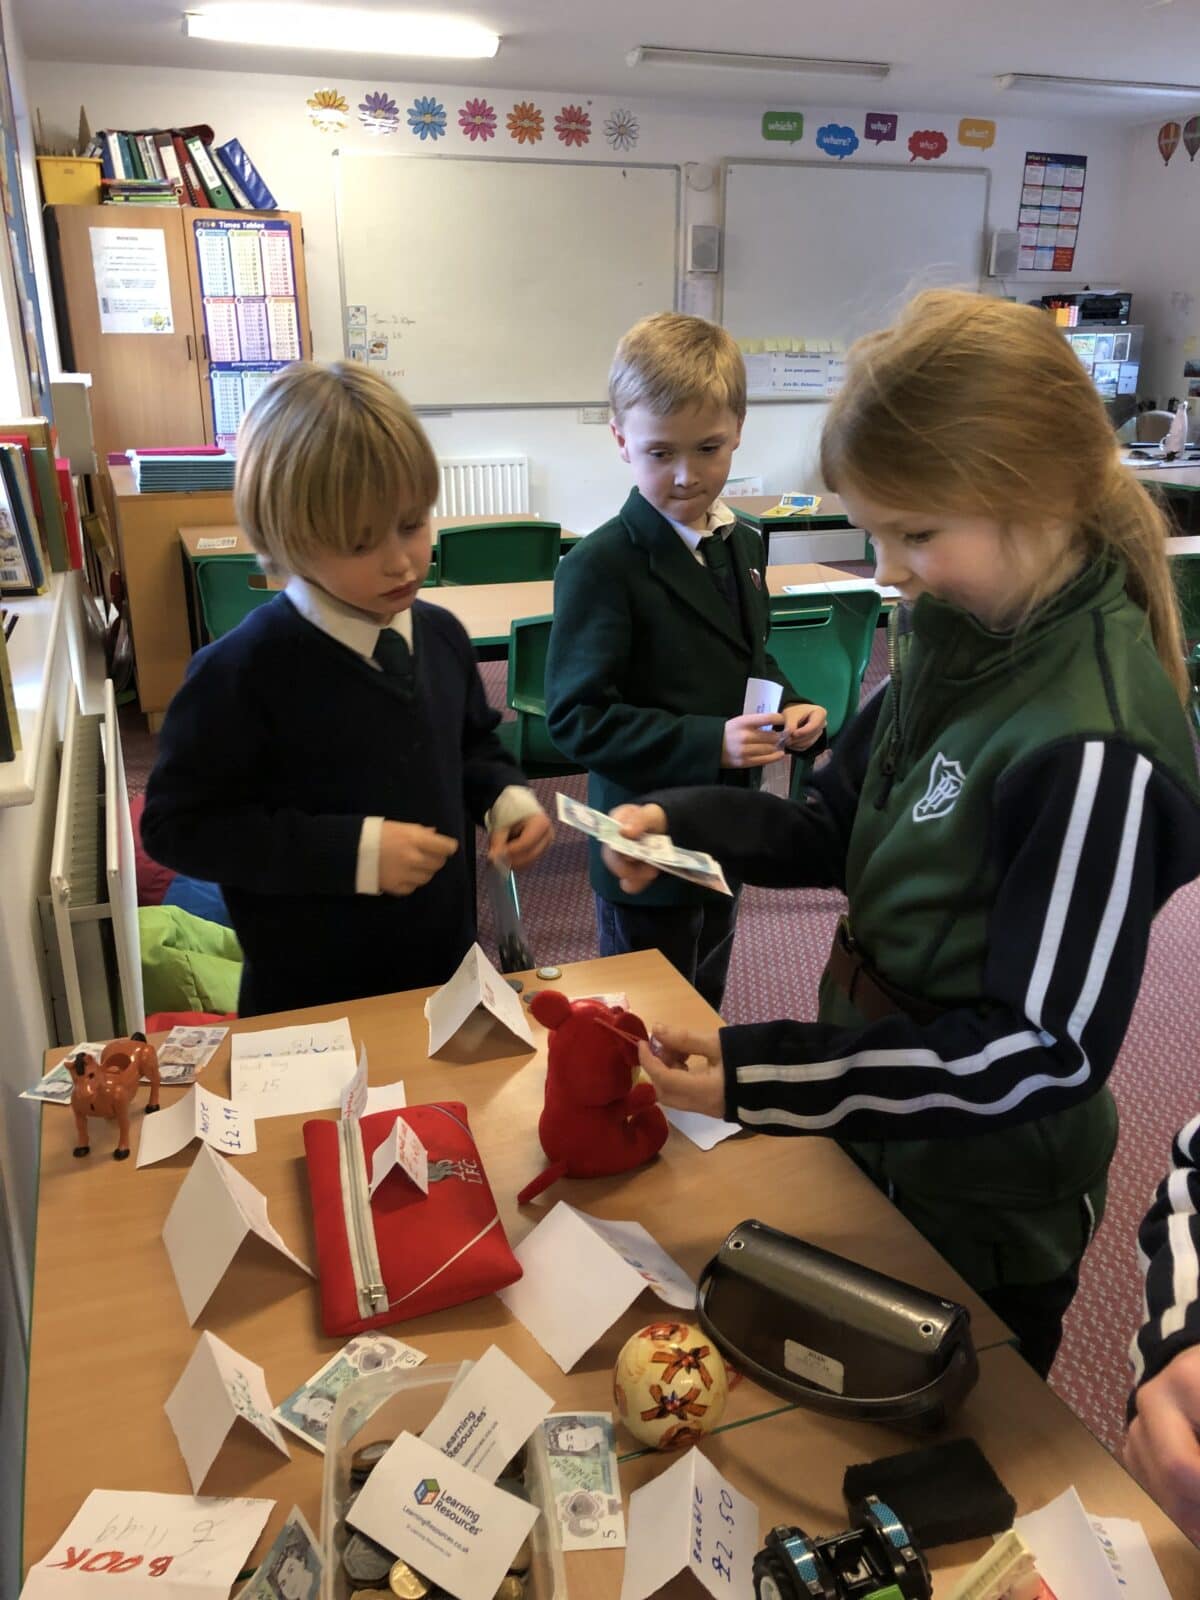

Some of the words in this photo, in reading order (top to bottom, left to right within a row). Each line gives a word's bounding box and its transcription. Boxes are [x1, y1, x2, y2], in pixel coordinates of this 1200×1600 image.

[767, 120, 798, 132] which?
[870, 121, 892, 133] why?
[822, 135, 852, 147] where?
[919, 140, 938, 150] who?
[219, 221, 241, 229] Times
[242, 221, 265, 229] Tables
[463, 1159, 483, 1185] LFC
[440, 1410, 477, 1455] Learning
[433, 1499, 481, 1536] Resources
[440, 1489, 481, 1524] Learning
[711, 1488, 736, 1584] £2.50
[46, 1546, 175, 1578] BOOK
